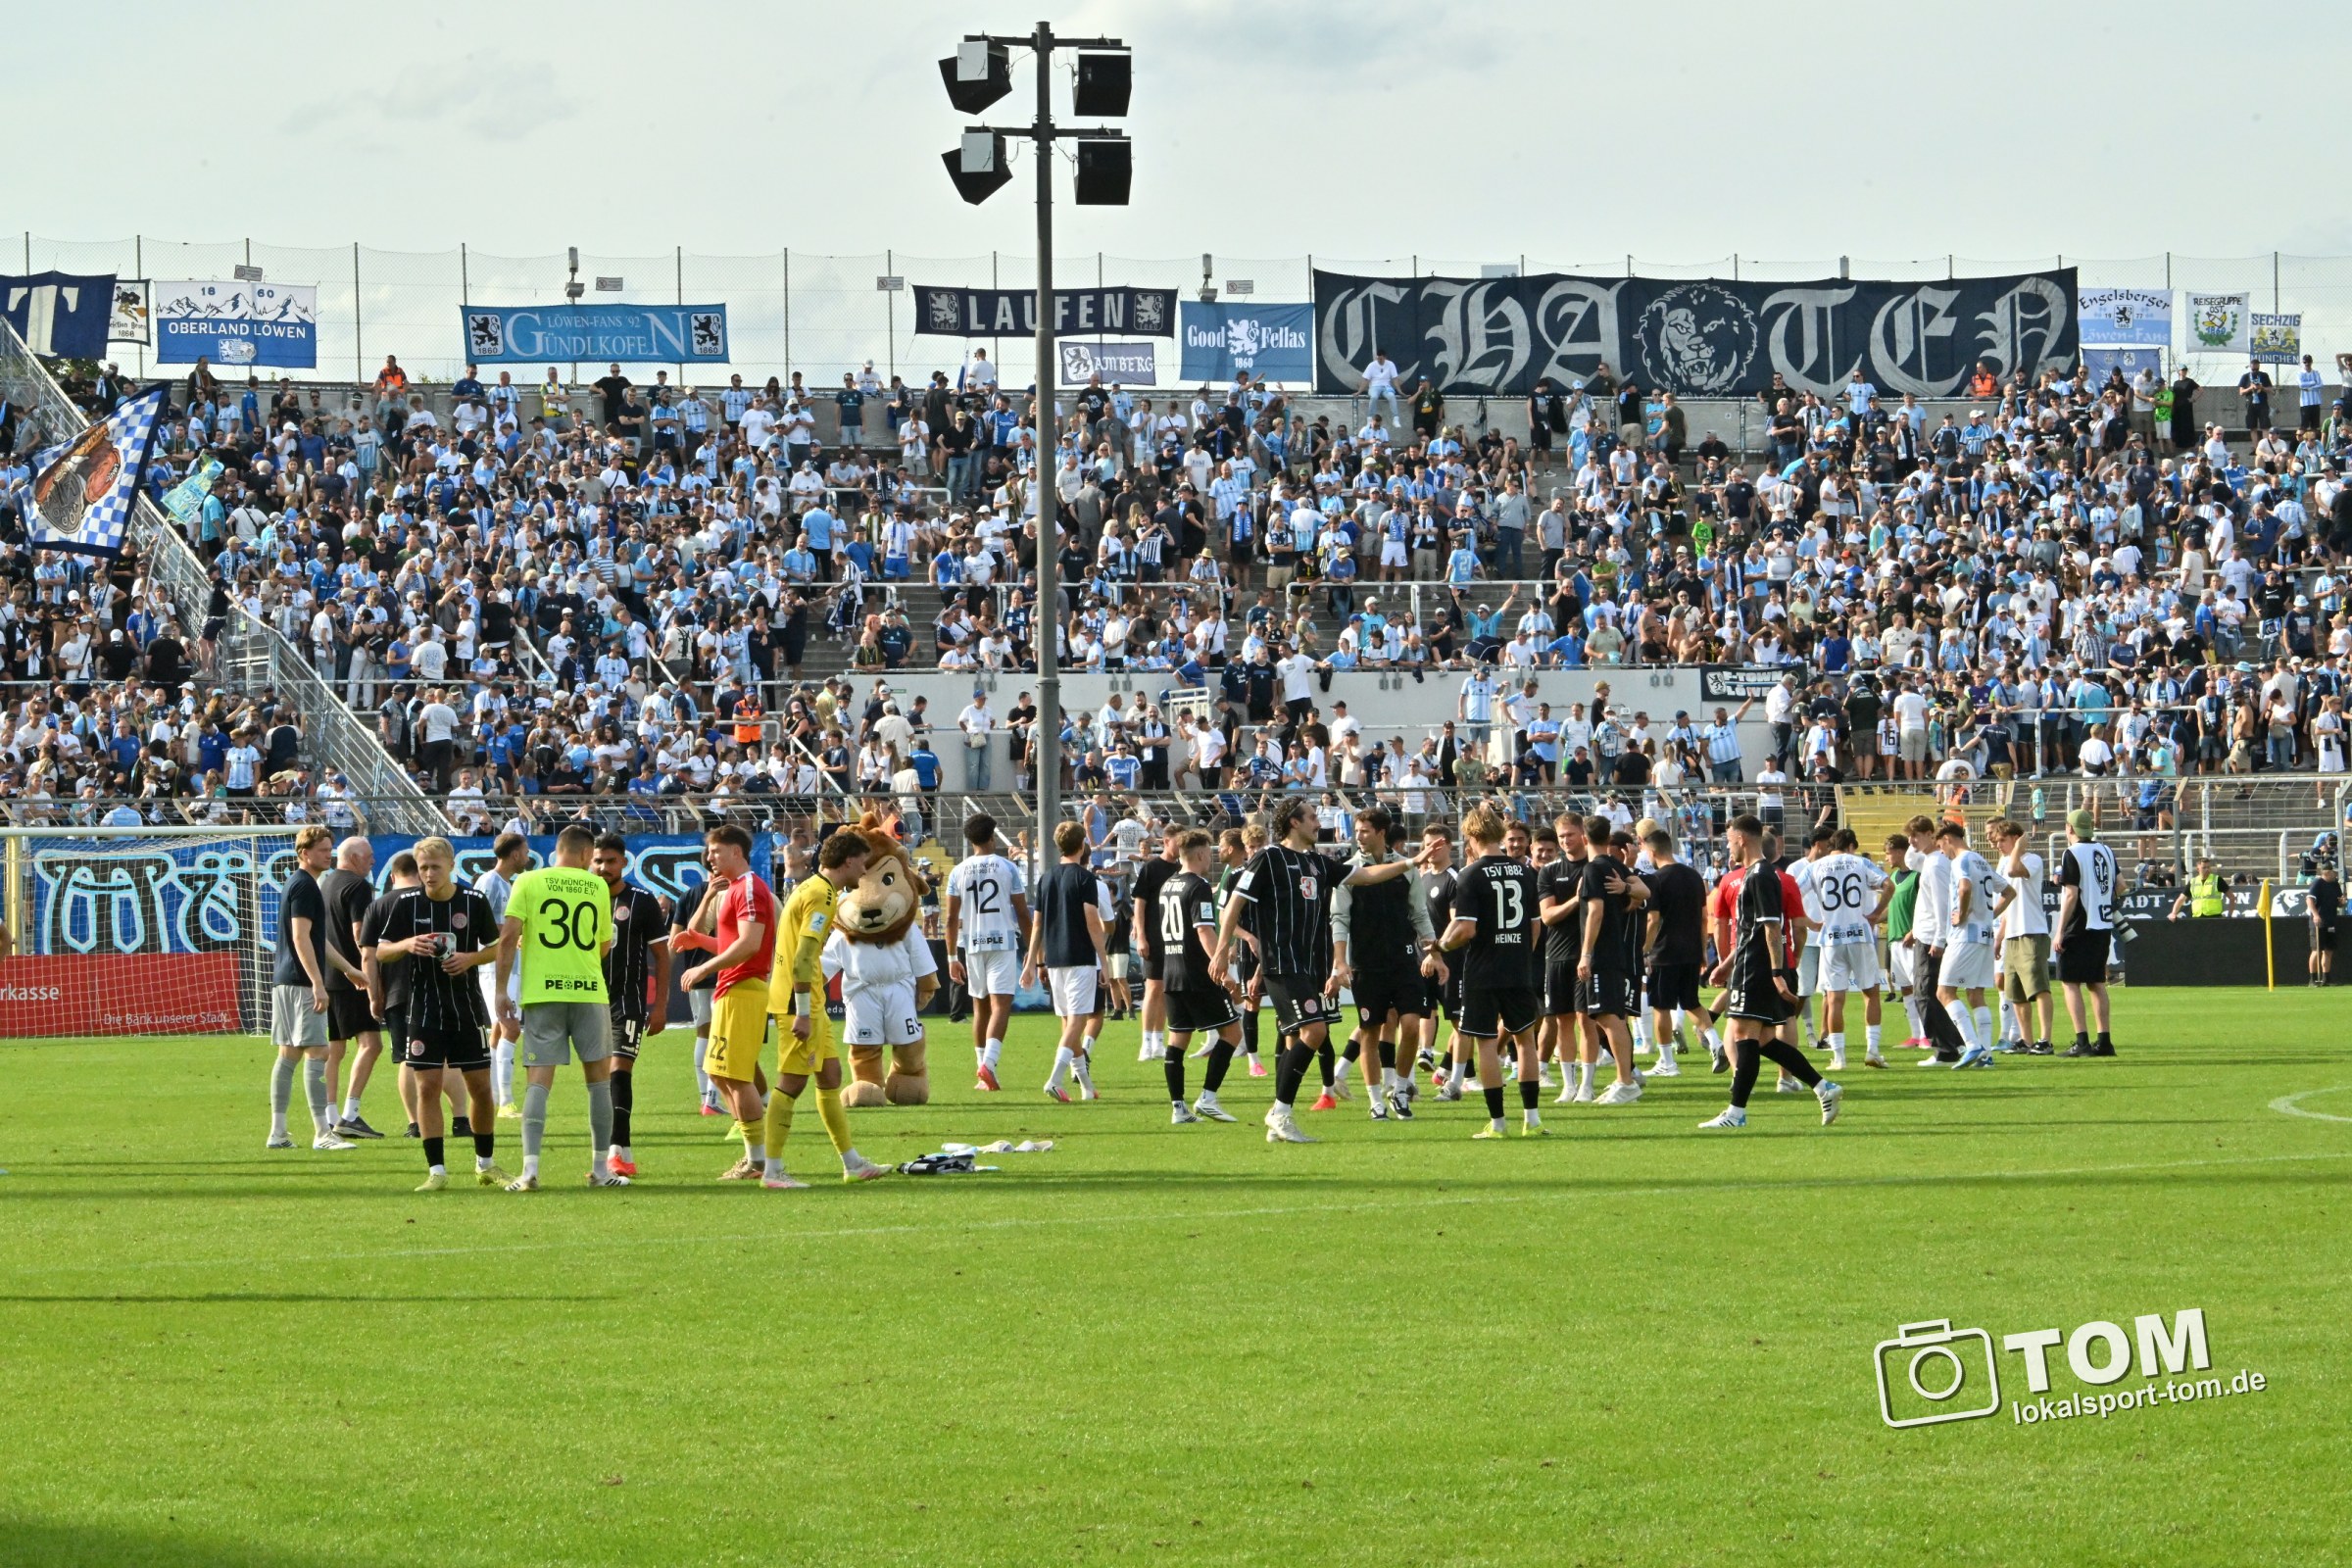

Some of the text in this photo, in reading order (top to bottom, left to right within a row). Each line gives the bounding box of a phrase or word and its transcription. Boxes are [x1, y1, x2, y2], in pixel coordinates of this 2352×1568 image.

[201, 287, 274, 298] 18 60
[2079, 289, 2171, 310] Engelsberger
[2193, 297, 2242, 306] REISEGRUPPE
[548, 315, 622, 328] LÖWEN-FANS
[2251, 314, 2301, 326] SECHZIG
[169, 321, 306, 338] OBERLAND LÖWEN
[1188, 324, 1305, 348] Good Fellas
[1094, 356, 1153, 372] AMBERG
[1235, 358, 1253, 368] 1860
[1884, 730, 1895, 745] 16
[1482, 864, 1524, 877] TSV 1882
[561, 878, 599, 890] MÜNCHEN
[1821, 873, 1862, 911] 36
[966, 878, 1001, 914] 12
[1491, 879, 1524, 929] 13
[539, 899, 598, 951] 30
[1159, 895, 1184, 941] 20
[1494, 933, 1522, 944] HEINZE
[105, 1013, 122, 1024] Die
[125, 1012, 153, 1024] Bank
[153, 1014, 197, 1024] unserer
[625, 1019, 636, 1043] 4
[710, 1035, 727, 1060] 22
